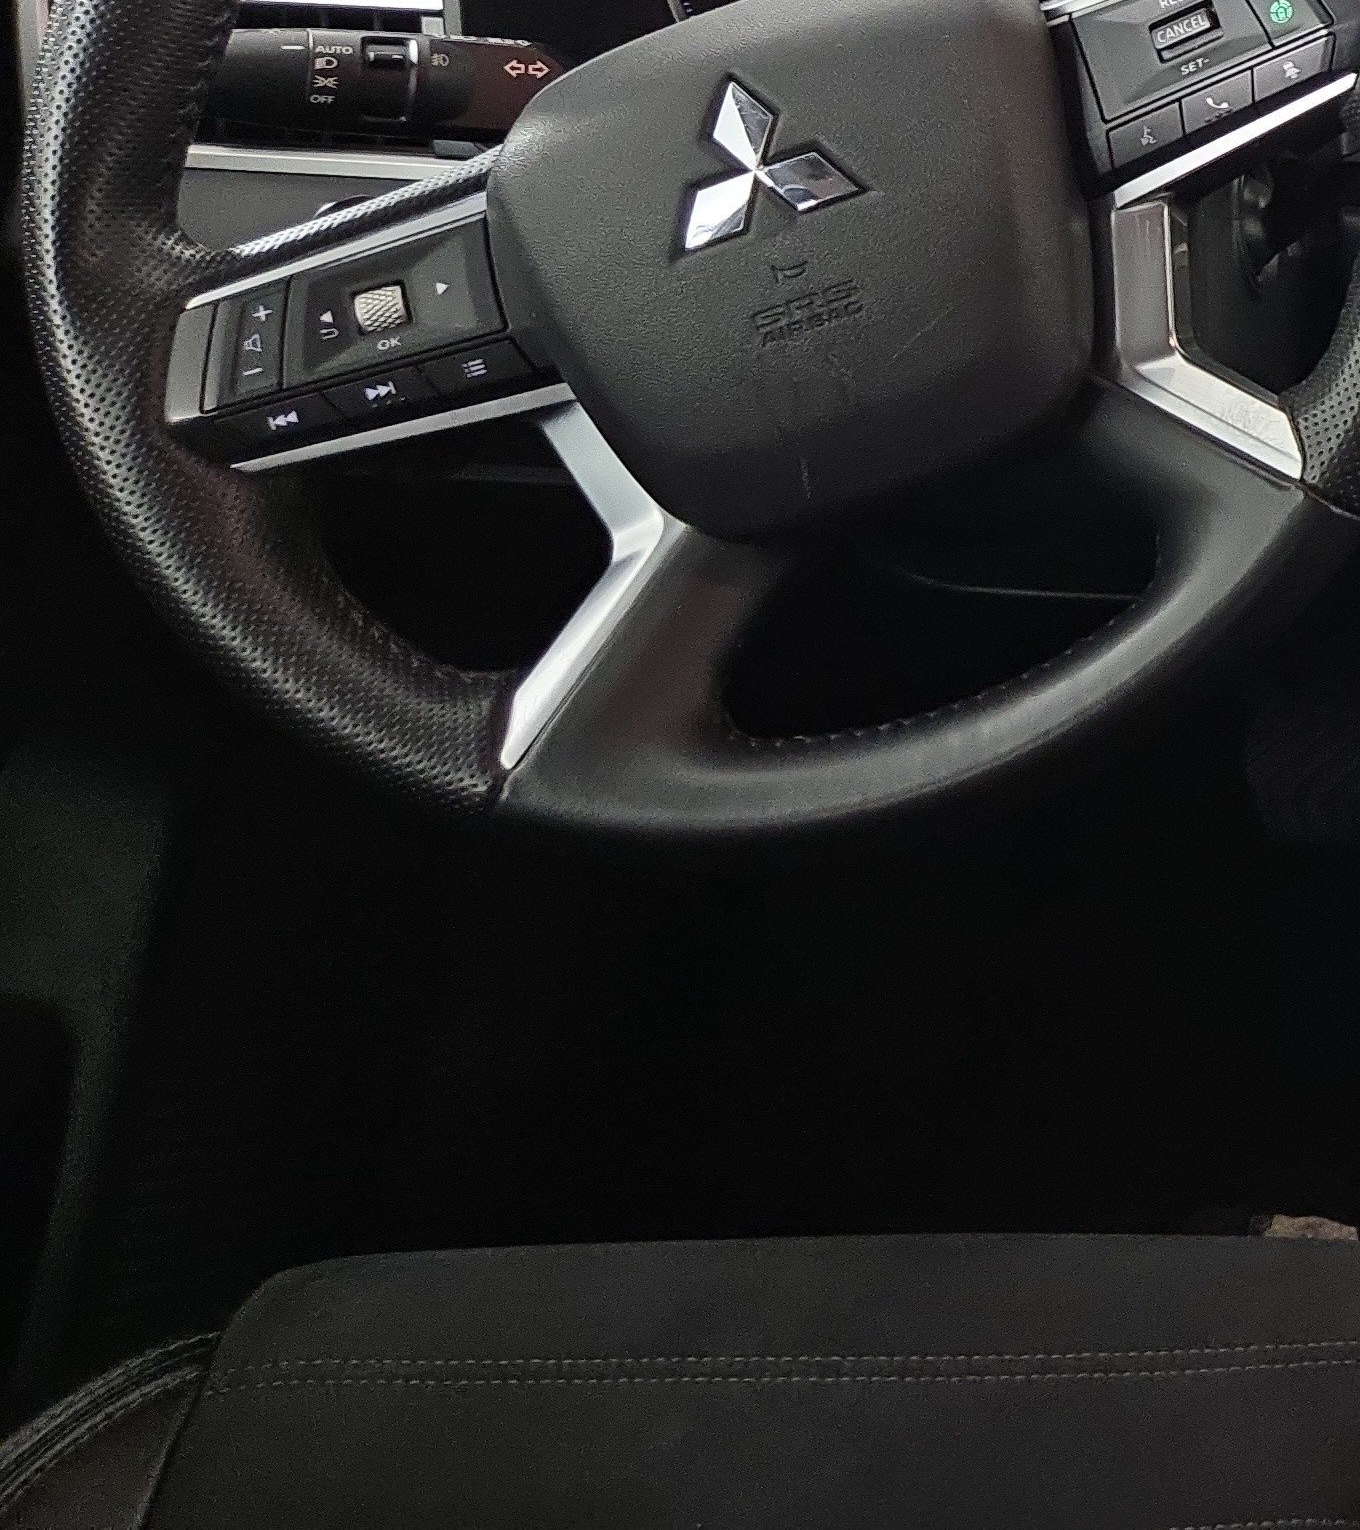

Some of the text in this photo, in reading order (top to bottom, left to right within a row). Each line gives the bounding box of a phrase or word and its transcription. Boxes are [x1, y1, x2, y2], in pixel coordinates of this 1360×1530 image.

[1156, 16, 1208, 44] CANCEL
[314, 44, 354, 55] AUTO
[309, 94, 336, 105] OFF
[375, 335, 402, 352] OK
